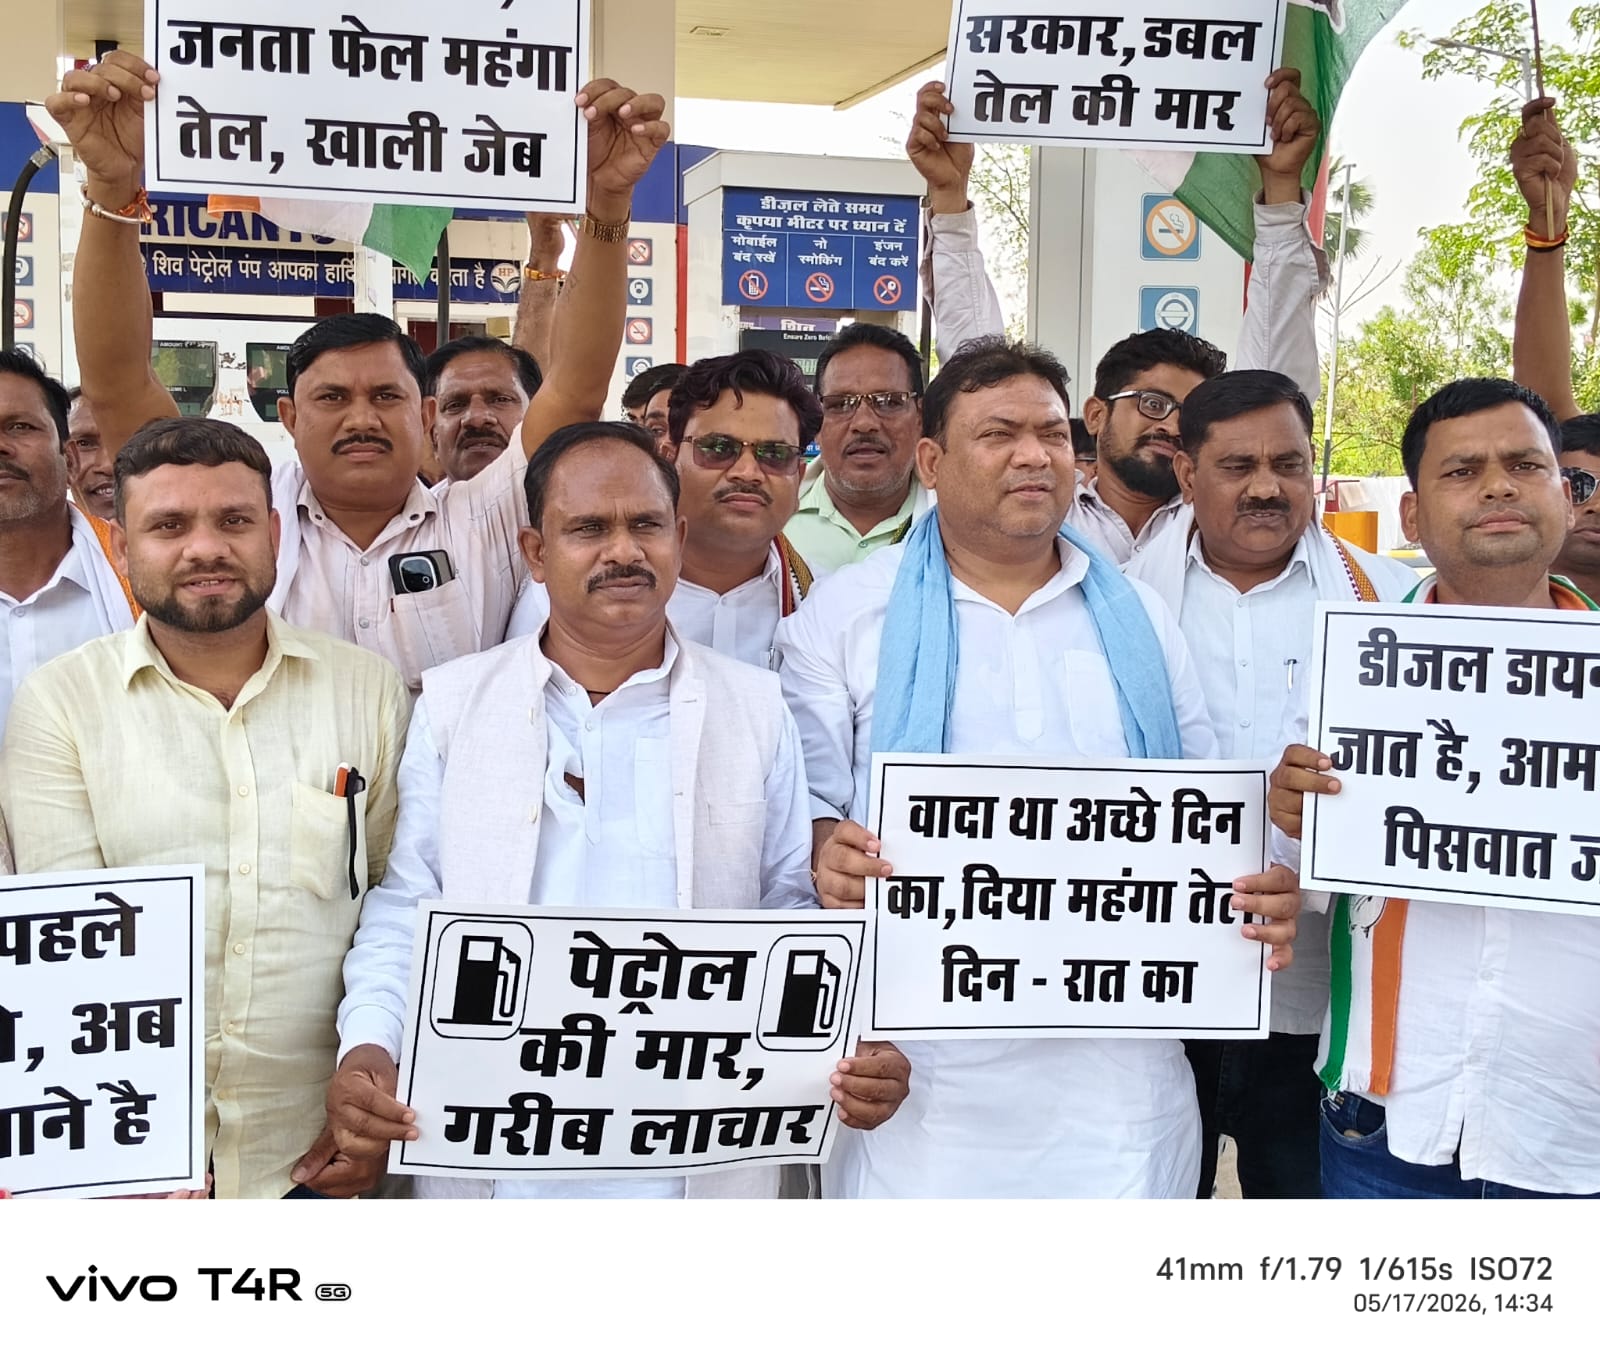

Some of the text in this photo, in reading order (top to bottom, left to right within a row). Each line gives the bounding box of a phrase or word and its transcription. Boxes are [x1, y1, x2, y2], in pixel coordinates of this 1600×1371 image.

[166, 14, 573, 92] जनता फेल महंगा
[973, 69, 1242, 131] तेल की मार
[176, 95, 548, 178] तेल, खाली जेब
[140, 202, 336, 245] RICAN
[736, 214, 909, 235] कृपया मीटर पर ध्यान दें
[813, 199, 841, 214] लेते
[844, 202, 885, 216] समय
[152, 250, 184, 276] शिव
[190, 250, 232, 284] पेट्रोल
[238, 253, 262, 279] पंप
[268, 260, 319, 281] आपका
[474, 261, 486, 290] है
[731, 233, 777, 249] मोबाईल
[732, 251, 777, 264] बंद रखें
[798, 253, 843, 267] स्मोकिंग
[813, 237, 829, 250] नो
[868, 254, 910, 268] बंद करें
[874, 239, 904, 252] इंजन
[498, 267, 515, 278] HP
[1358, 627, 1600, 700] डीजल डाय
[1329, 726, 1423, 778] जात
[1426, 718, 1481, 794] है,
[908, 786, 1246, 845] वादा था अच्छे दिन
[1383, 805, 1558, 880] पिसवात
[1067, 867, 1178, 923] महंगा
[568, 930, 758, 1016] पेट्रोल
[941, 944, 1021, 1003] दिन
[1062, 959, 1131, 1003] रात
[1141, 960, 1199, 1004] का
[71, 997, 183, 1055] अब
[519, 1013, 766, 1091] की मार,
[95, 1079, 157, 1146] है
[443, 1091, 826, 1157] गरीब लाचार
